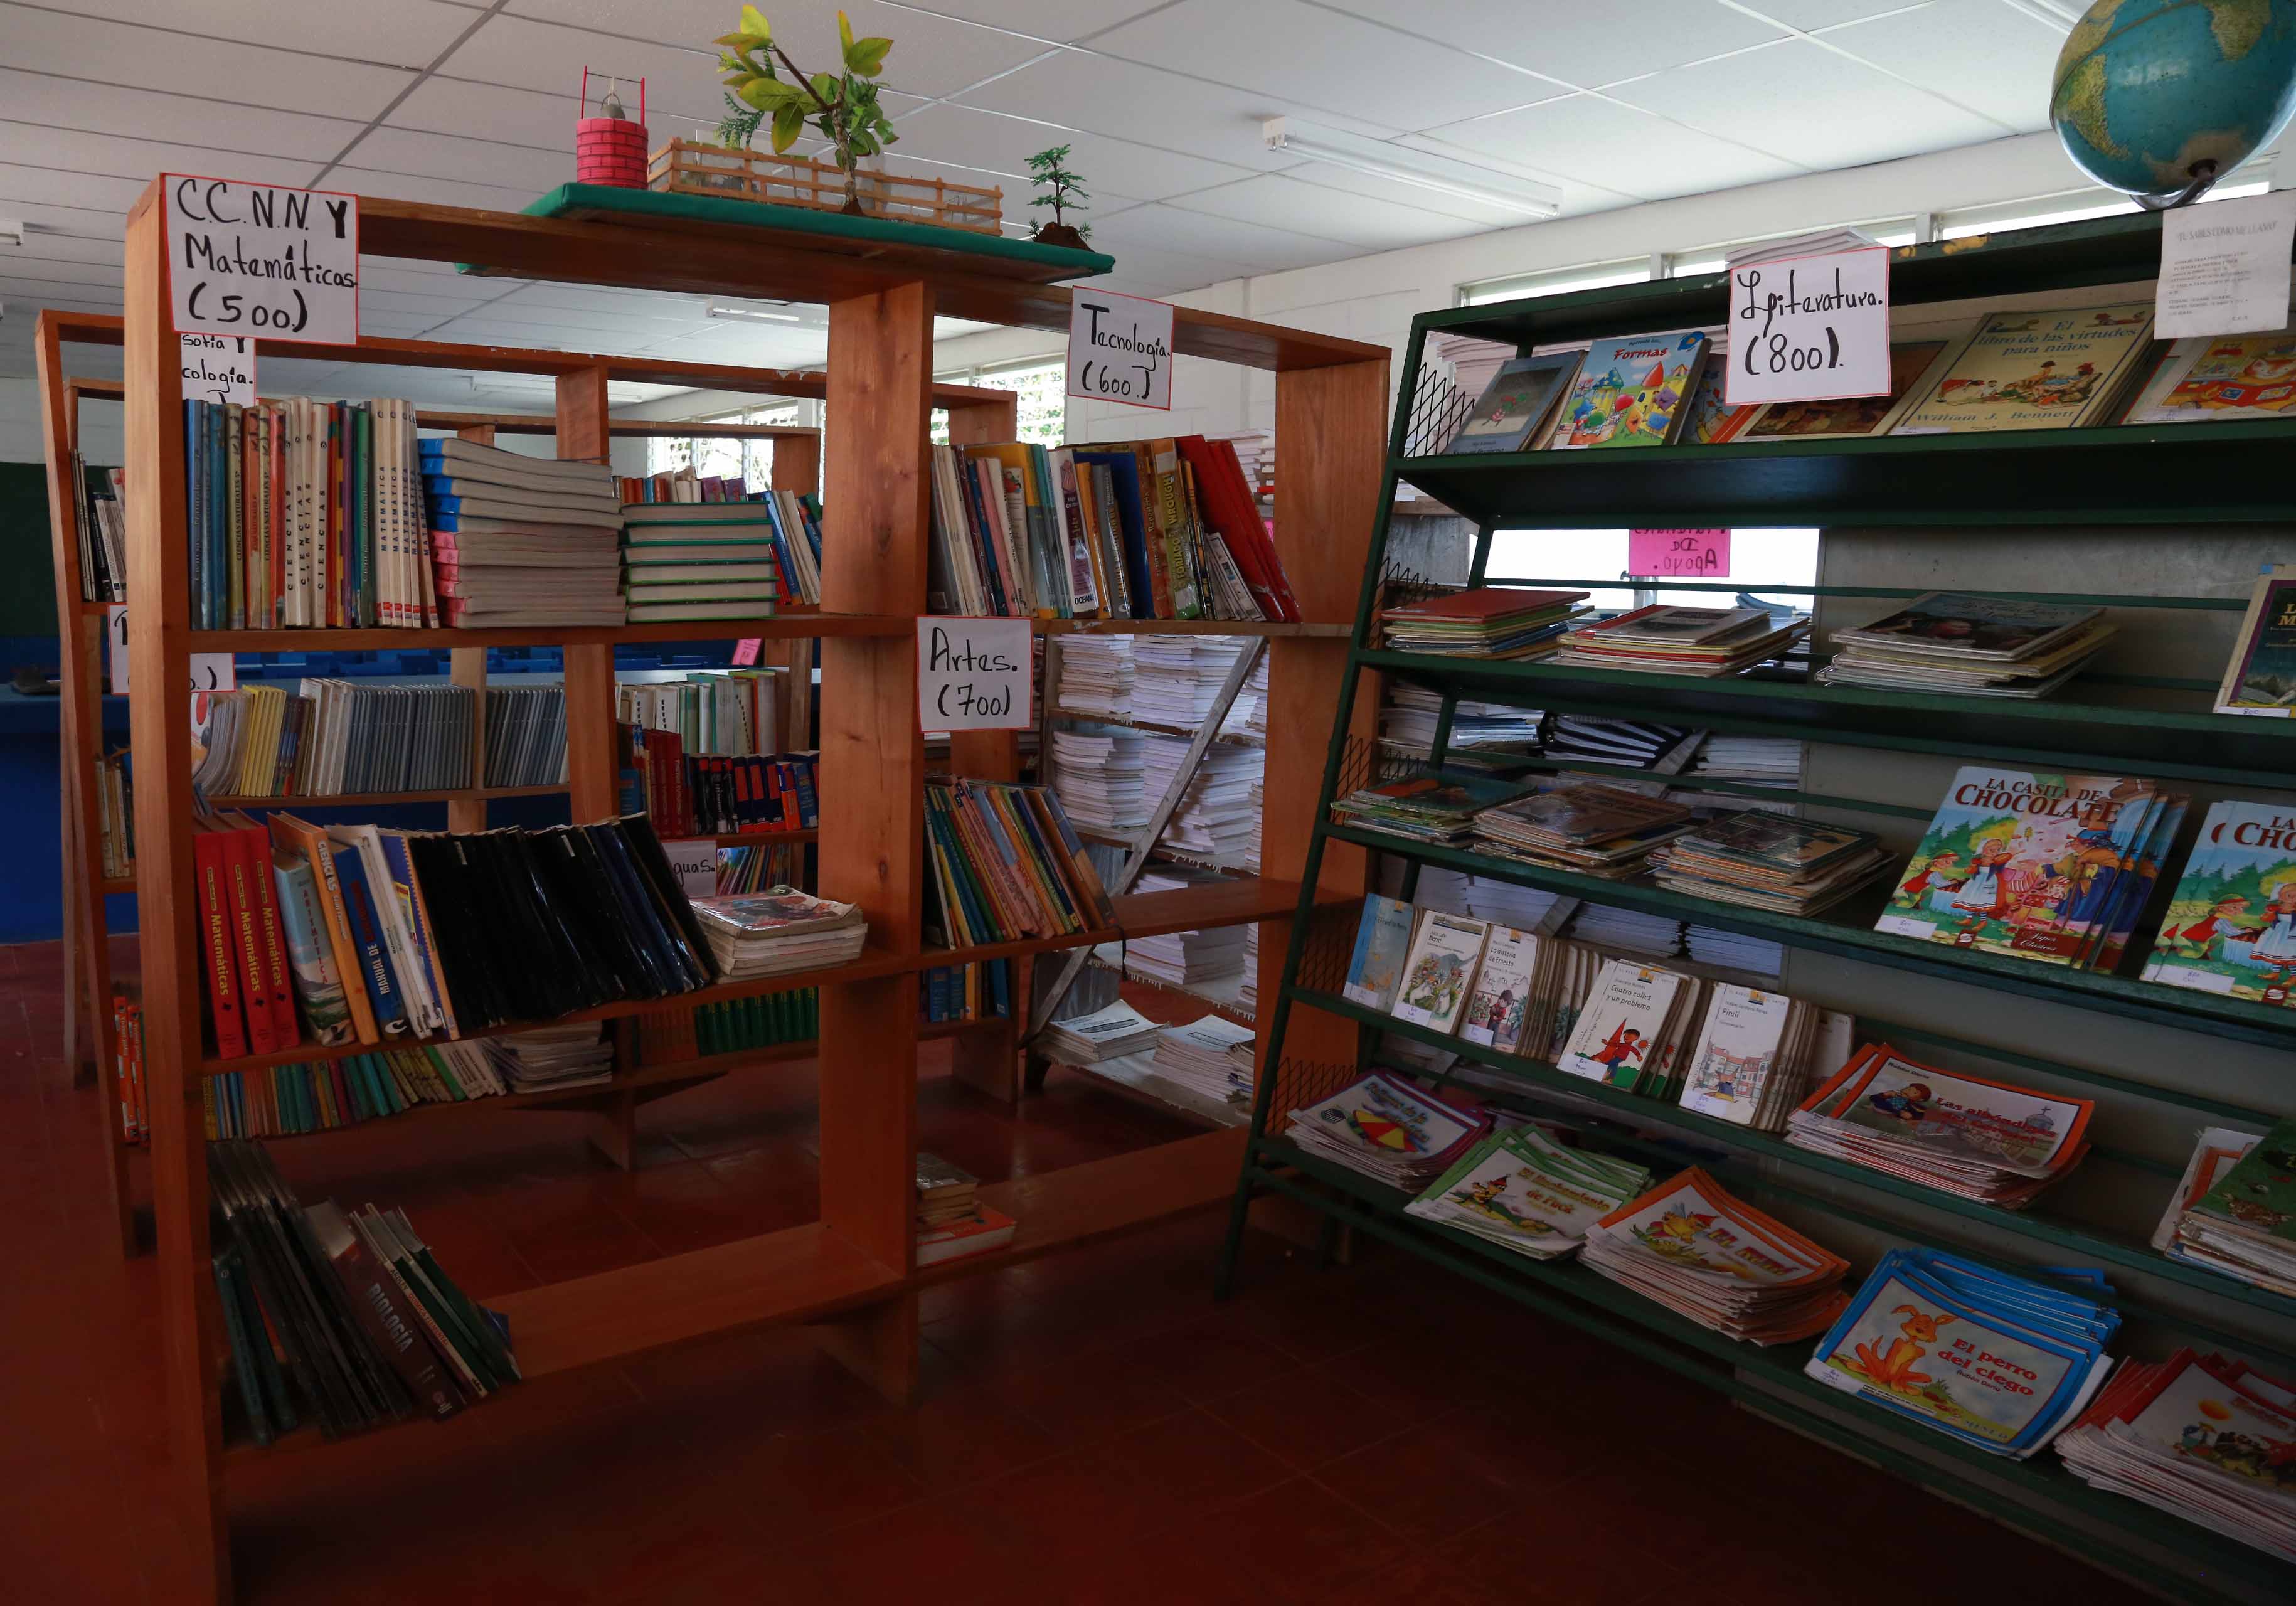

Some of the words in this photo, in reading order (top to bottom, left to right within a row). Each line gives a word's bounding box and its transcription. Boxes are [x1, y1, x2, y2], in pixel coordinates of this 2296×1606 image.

[1613, 348, 1669, 361] Formas
[285, 490, 294, 591] CIENCIAS
[297, 486, 307, 585] CIENCIAS
[930, 627, 1018, 671] Artes.
[1955, 784, 2125, 824] CHOCOLATE
[1985, 777, 2006, 790] LA
[2012, 781, 2069, 799] CASITA
[2076, 789, 2103, 802] DE
[2270, 816, 2295, 830] LA
[317, 840, 336, 892] CIENCIAS
[211, 913, 229, 996] Matemáticas
[241, 910, 261, 992] Matemáticas
[262, 907, 283, 986] Matemáticas
[367, 943, 380, 957] DE
[371, 959, 391, 995] MANUAL
[1611, 984, 1632, 996] Cuatro
[1633, 991, 1652, 1001] calles
[1620, 998, 1651, 1011] problema
[368, 1282, 413, 1355] BIOLOGÍA
[1938, 1350, 1972, 1369] del
[1976, 1368, 2034, 1396] ciego
[1952, 1338, 1976, 1354] El
[1977, 1351, 2038, 1381] perro
